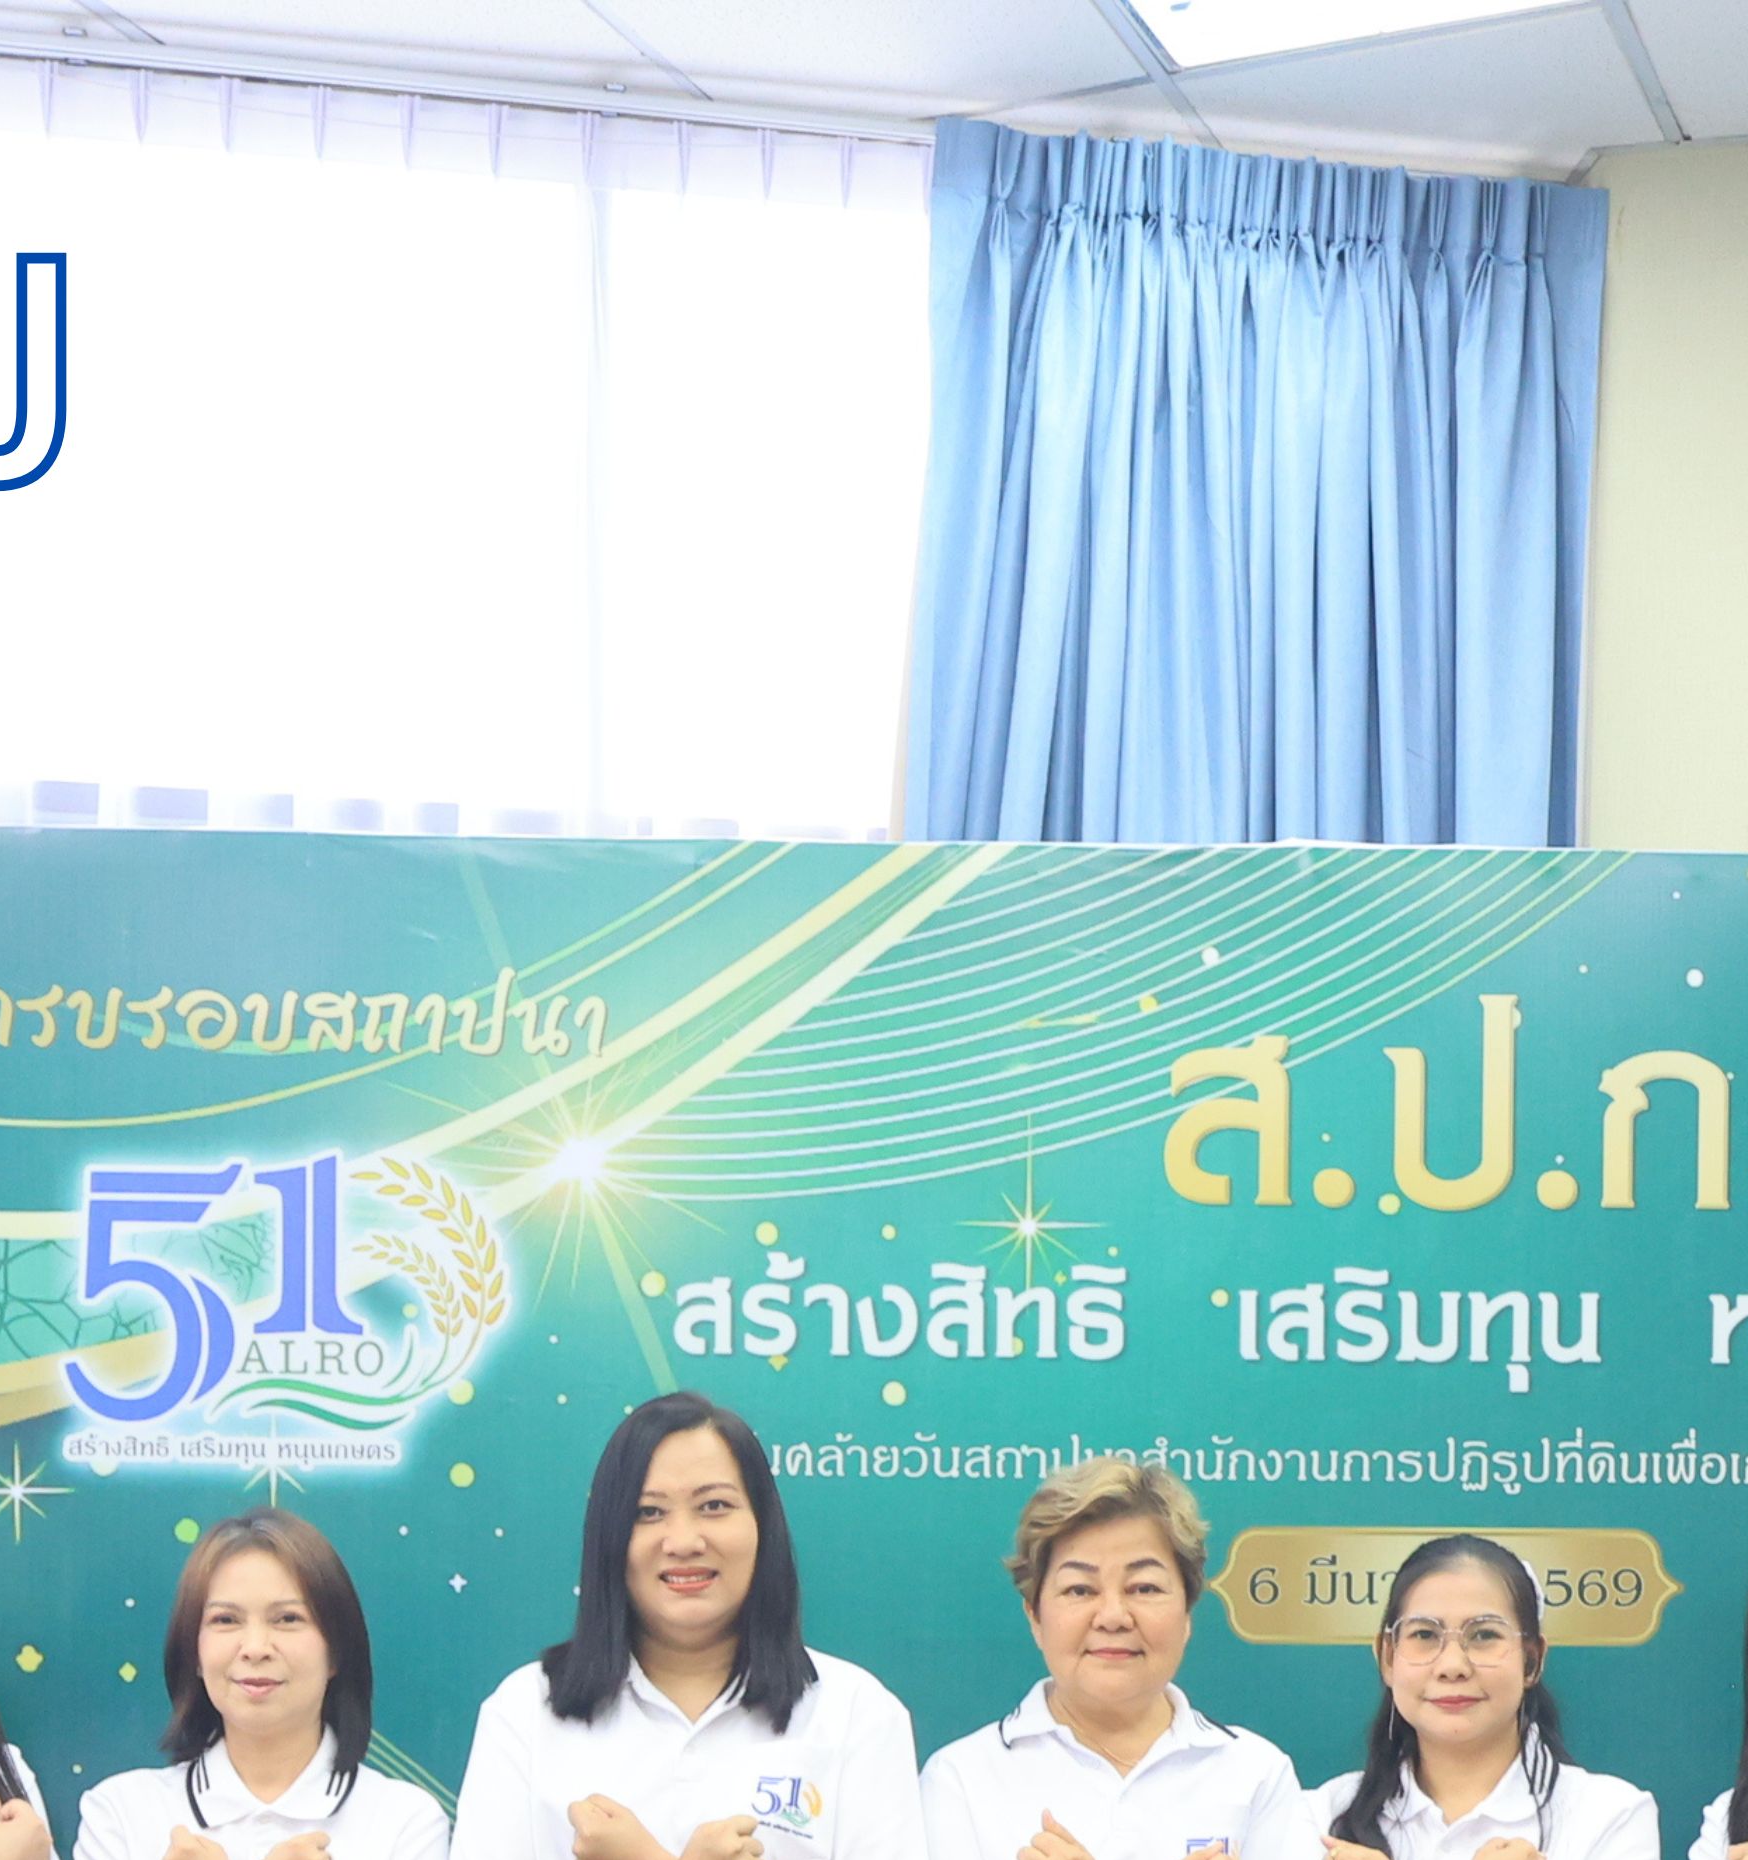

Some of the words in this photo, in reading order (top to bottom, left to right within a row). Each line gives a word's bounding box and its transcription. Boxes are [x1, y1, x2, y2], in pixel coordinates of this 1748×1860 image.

[65, 1155, 363, 1422] 51
[673, 1250, 1127, 1361] สร้างสิทธิ
[1238, 1266, 1602, 1393] เสริมทุน
[237, 1340, 384, 1377] ALRO
[67, 1433, 170, 1458] สร้างสิทธิ
[180, 1436, 266, 1466] เสริมทุน
[277, 1440, 396, 1466] หนุนเกษตร
[1249, 1567, 1280, 1605] 6
[1543, 1567, 1643, 1607] 569
[751, 1775, 801, 1816] 51
